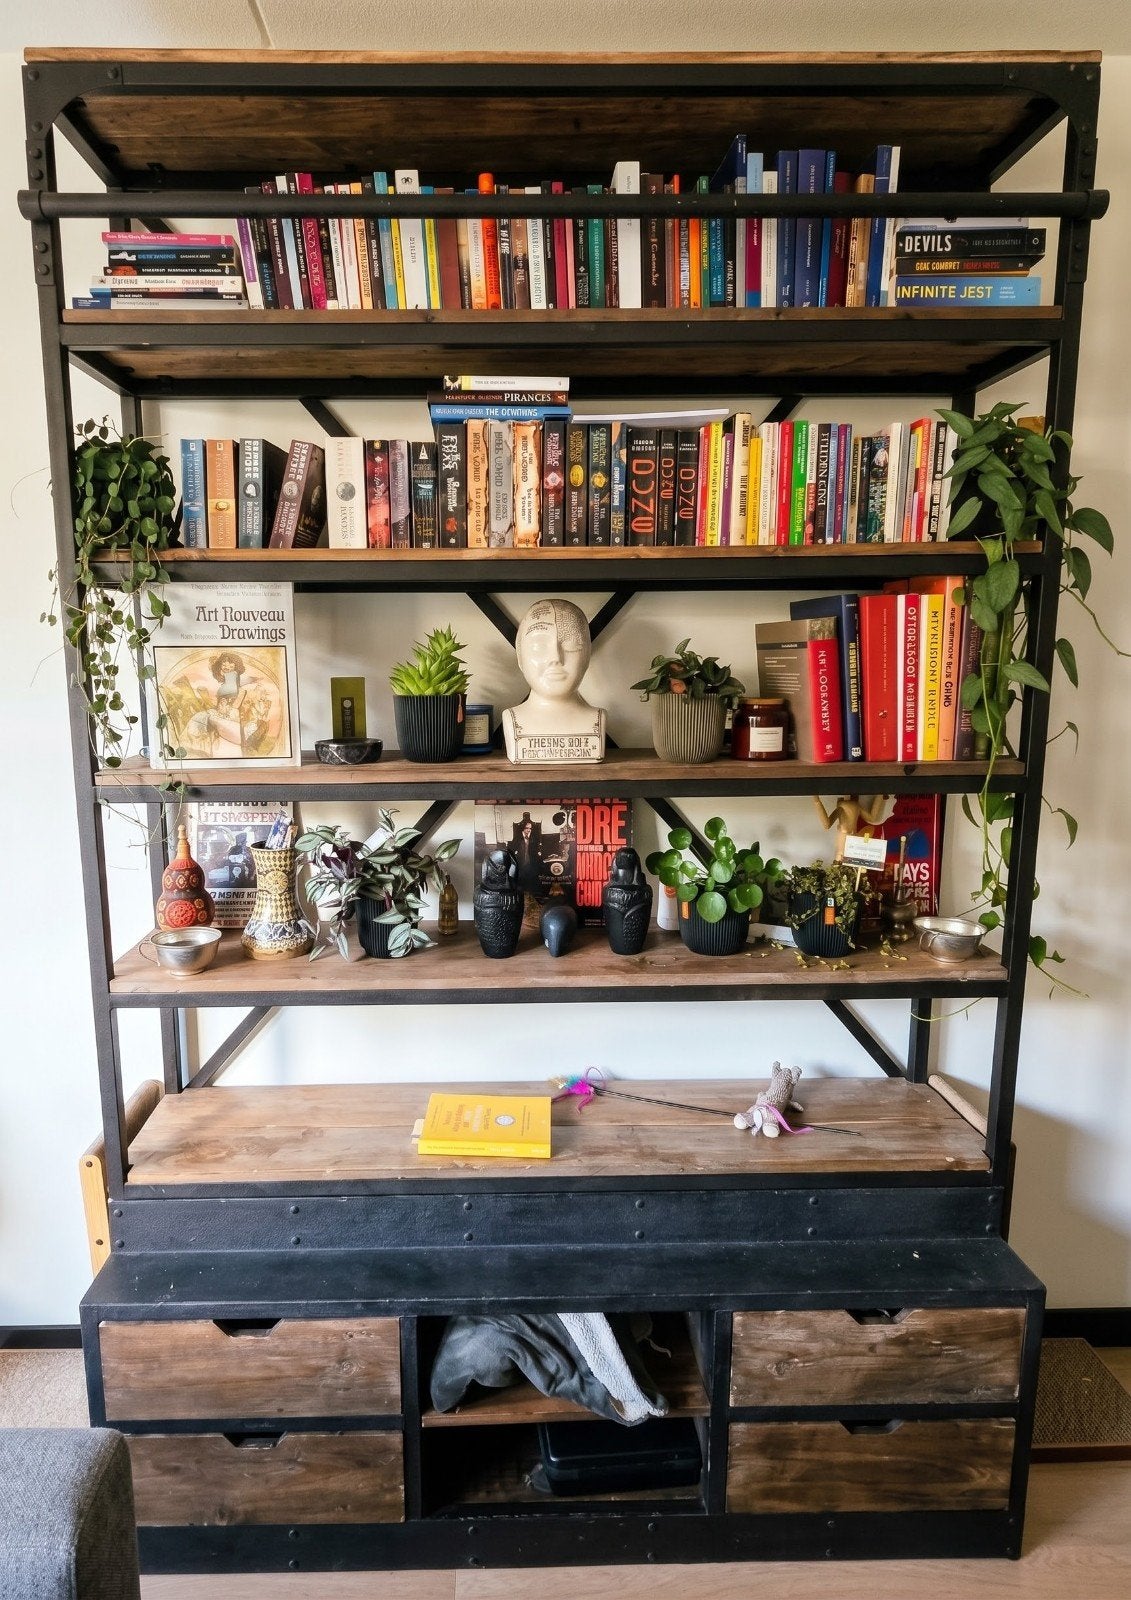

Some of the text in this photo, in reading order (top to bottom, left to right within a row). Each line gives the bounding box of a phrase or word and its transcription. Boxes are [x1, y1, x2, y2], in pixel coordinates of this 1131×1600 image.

[904, 234, 952, 253] DEVILS
[896, 285, 957, 299] INFINITE
[959, 285, 994, 299] JEST
[485, 408, 499, 416] THE
[195, 606, 286, 622] Art Nouveau
[218, 624, 286, 643] Drawings
[576, 804, 628, 845] DRE
